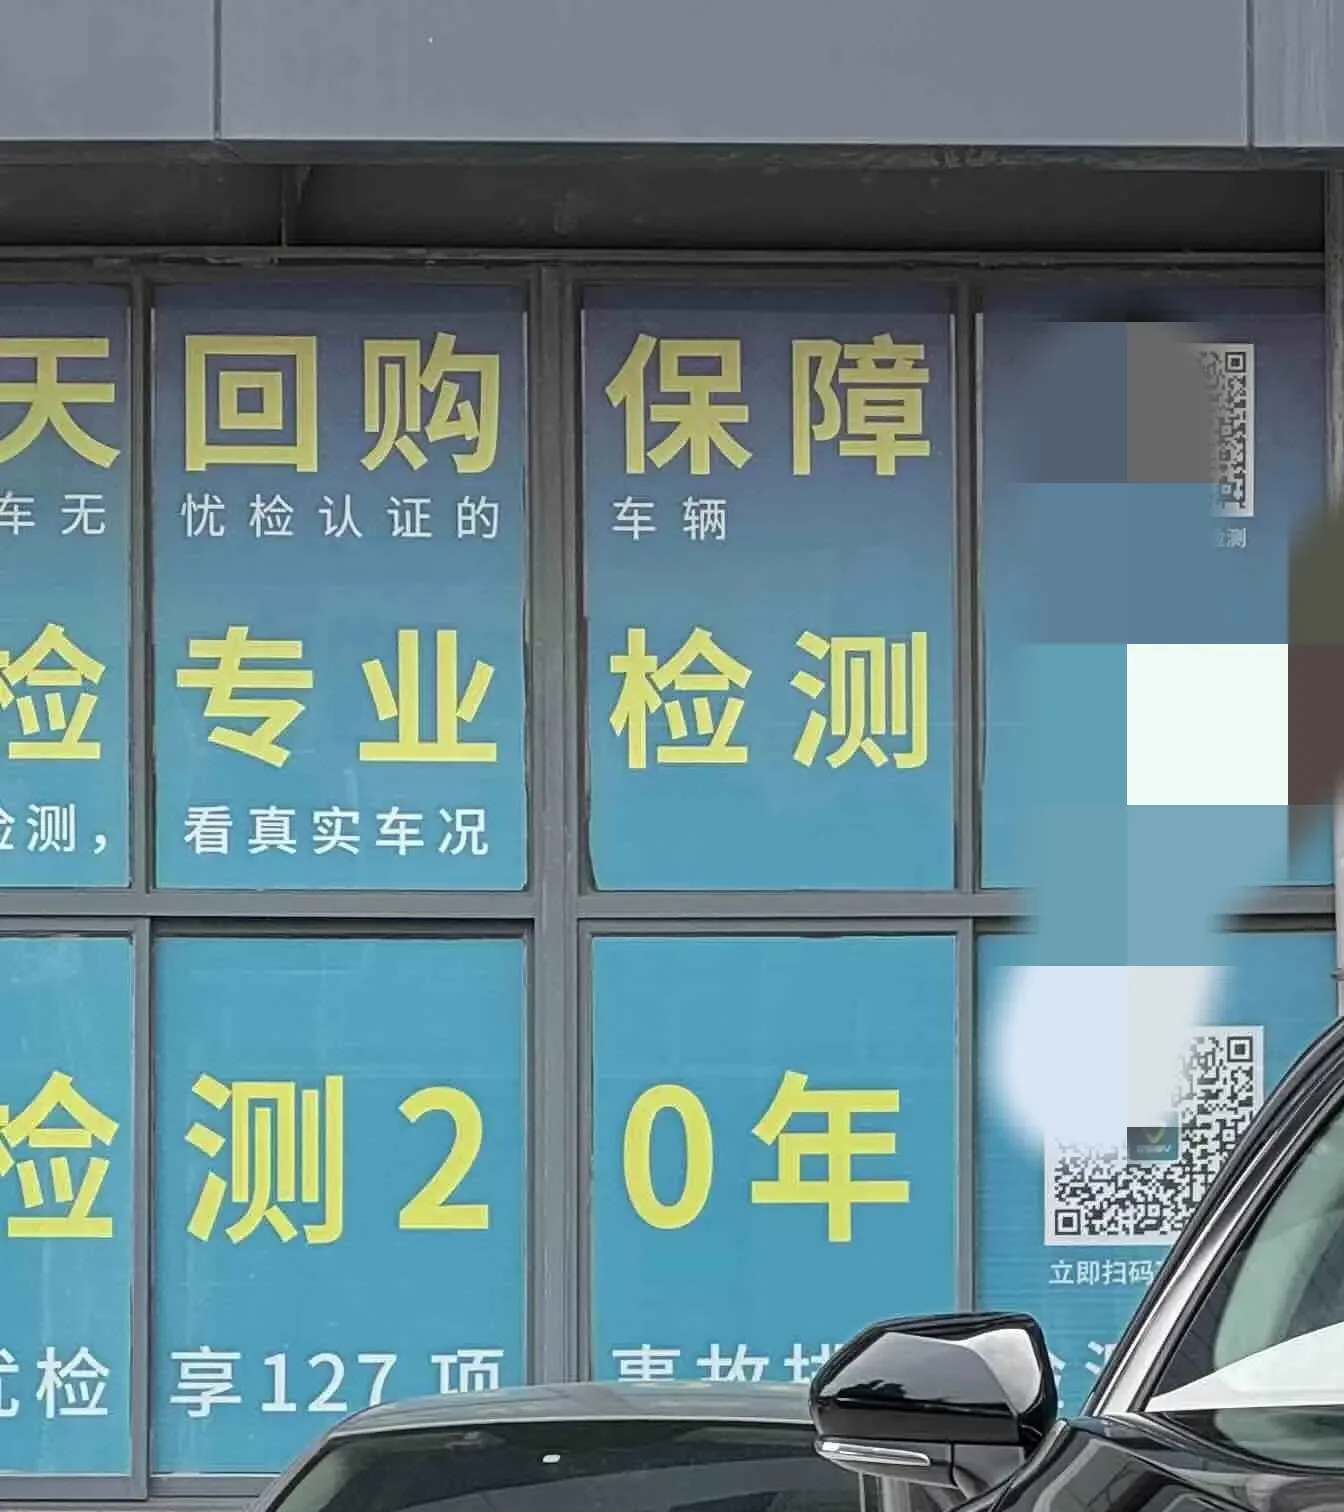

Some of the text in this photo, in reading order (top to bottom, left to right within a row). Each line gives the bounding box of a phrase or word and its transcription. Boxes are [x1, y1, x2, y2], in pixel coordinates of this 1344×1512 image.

[0, 333, 931, 476] 天 回购 保障
[0, 490, 728, 541] 车无 忧检认证的 车辆
[176, 625, 498, 769] 专业
[609, 627, 928, 770] 检测
[183, 805, 489, 857] 看真实车况
[1048, 1259, 1164, 1287] 立即扫码
[0, 1346, 110, 1419] 检
